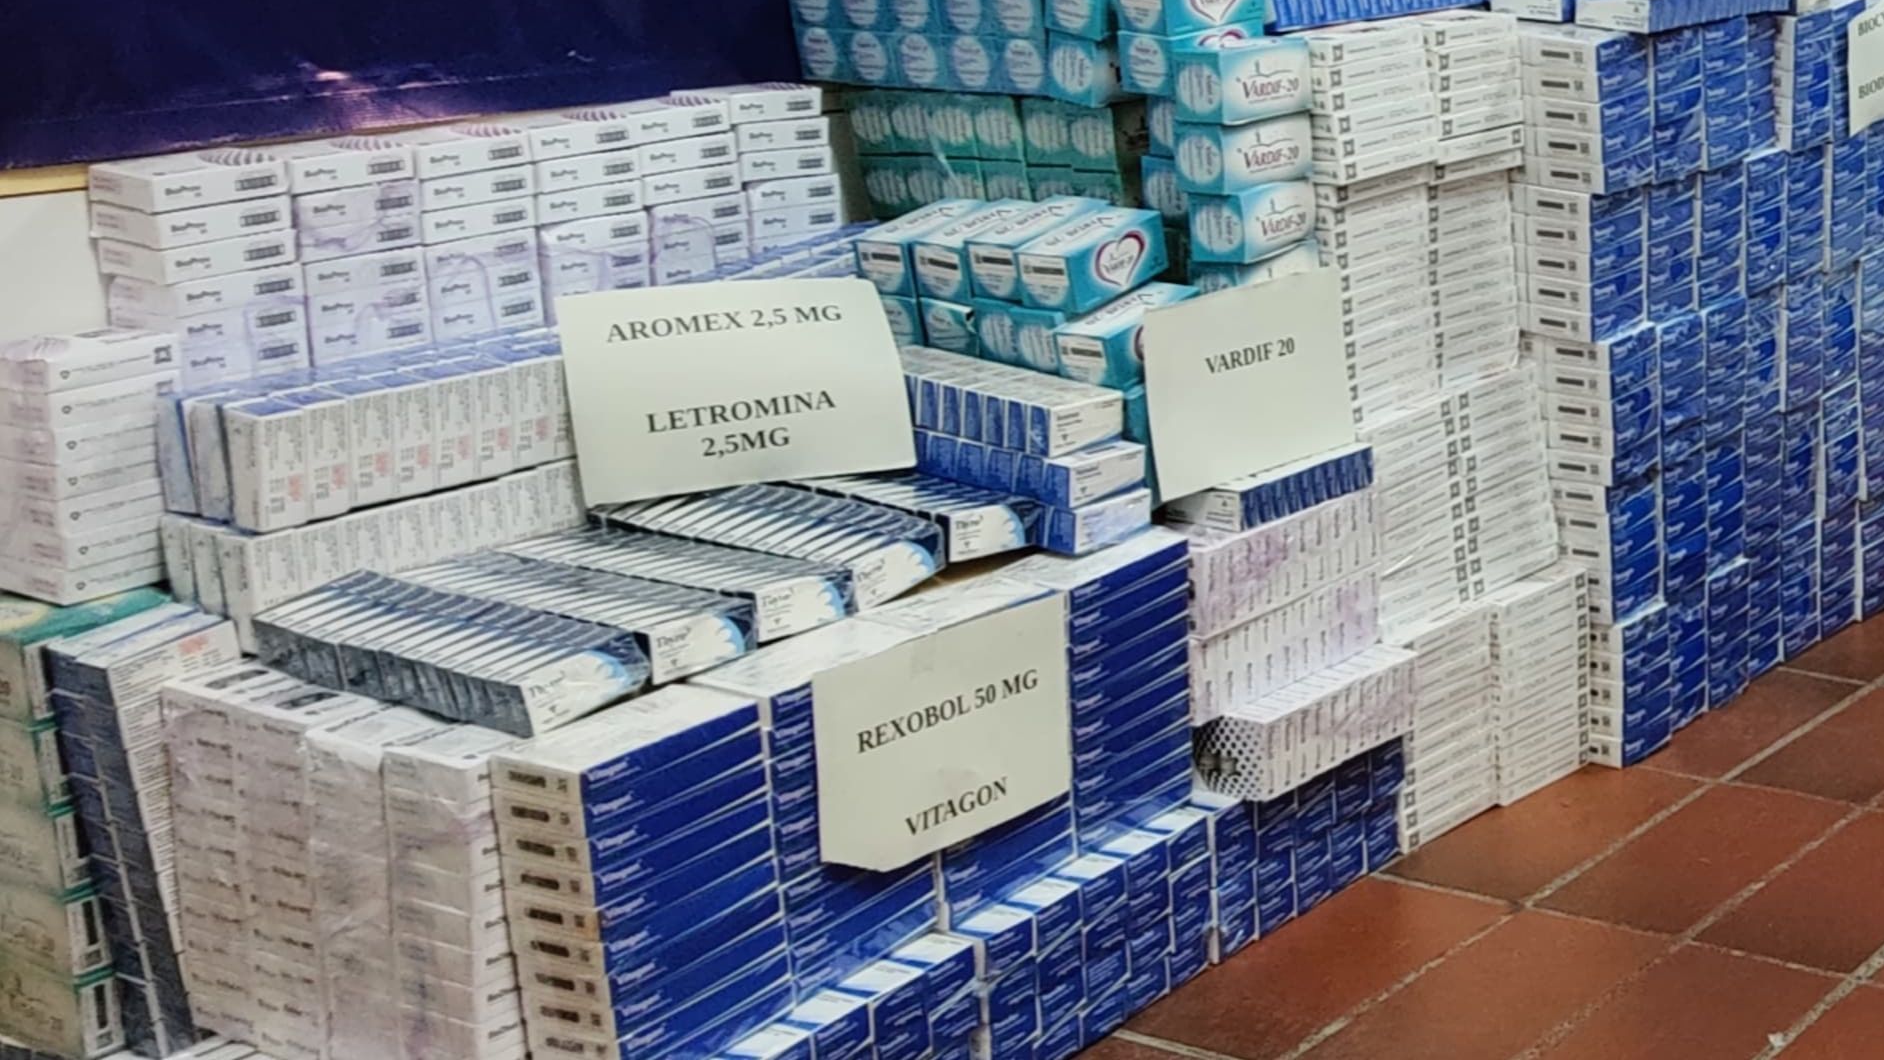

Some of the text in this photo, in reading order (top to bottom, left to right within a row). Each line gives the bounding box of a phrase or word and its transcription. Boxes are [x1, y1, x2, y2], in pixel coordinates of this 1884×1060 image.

[606, 304, 843, 344] AROMEX 2,5 MG
[1204, 337, 1296, 376] VARDIF 20
[646, 390, 837, 434] LETROMINA
[701, 426, 792, 459] 2,5MG
[856, 668, 1040, 755] REXOBOL 50 MG
[904, 776, 1010, 837] VITAGON
